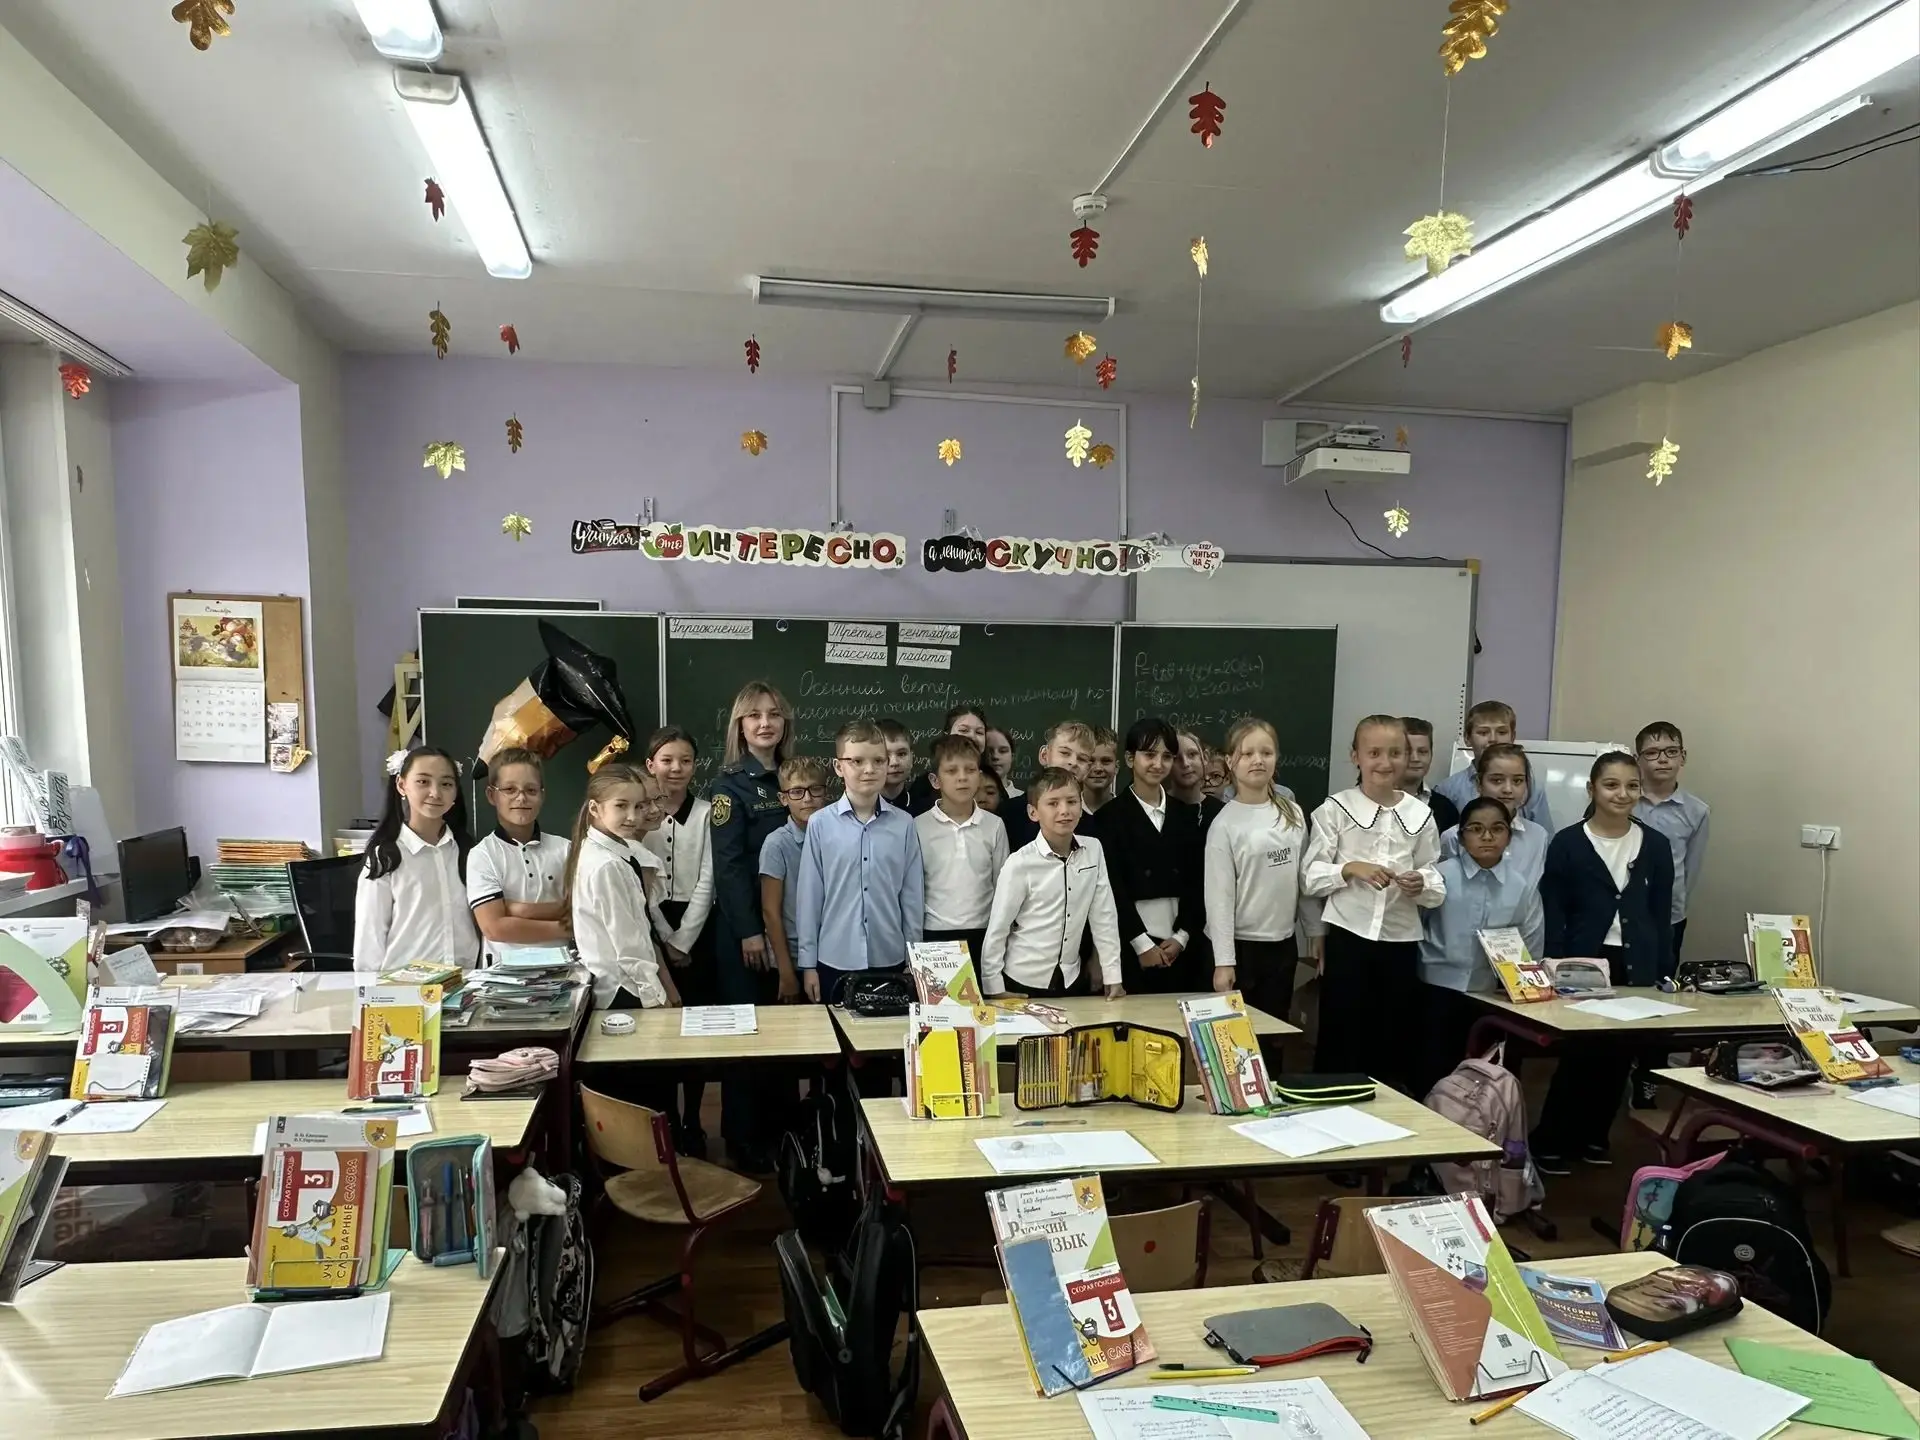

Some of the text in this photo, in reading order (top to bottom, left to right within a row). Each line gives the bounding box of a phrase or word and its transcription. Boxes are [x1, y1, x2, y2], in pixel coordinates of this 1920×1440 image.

[573, 521, 639, 552] Учиться
[928, 545, 937, 560] а
[939, 541, 985, 567] лениться
[1189, 550, 1220, 559] УЧИТЬСЯ
[1192, 558, 1203, 566] НА
[671, 618, 752, 639] Упражнение
[829, 622, 959, 643] Третье сентября
[826, 644, 947, 665] Классная работа
[800, 670, 961, 710] Осенний ветер
[102, 1023, 117, 1032] 3
[282, 1156, 296, 1218] СКОРАЯ ПОМОЩЬ
[304, 1174, 325, 1185] 3
[336, 1158, 359, 1279] СЛОВАРНЫЕ СЛОВА
[1050, 1232, 1089, 1253] ЗЫК
[1071, 1276, 1121, 1295] СКОРАЯ ПОМОЩЬ
[1103, 1298, 1118, 1321] 3
